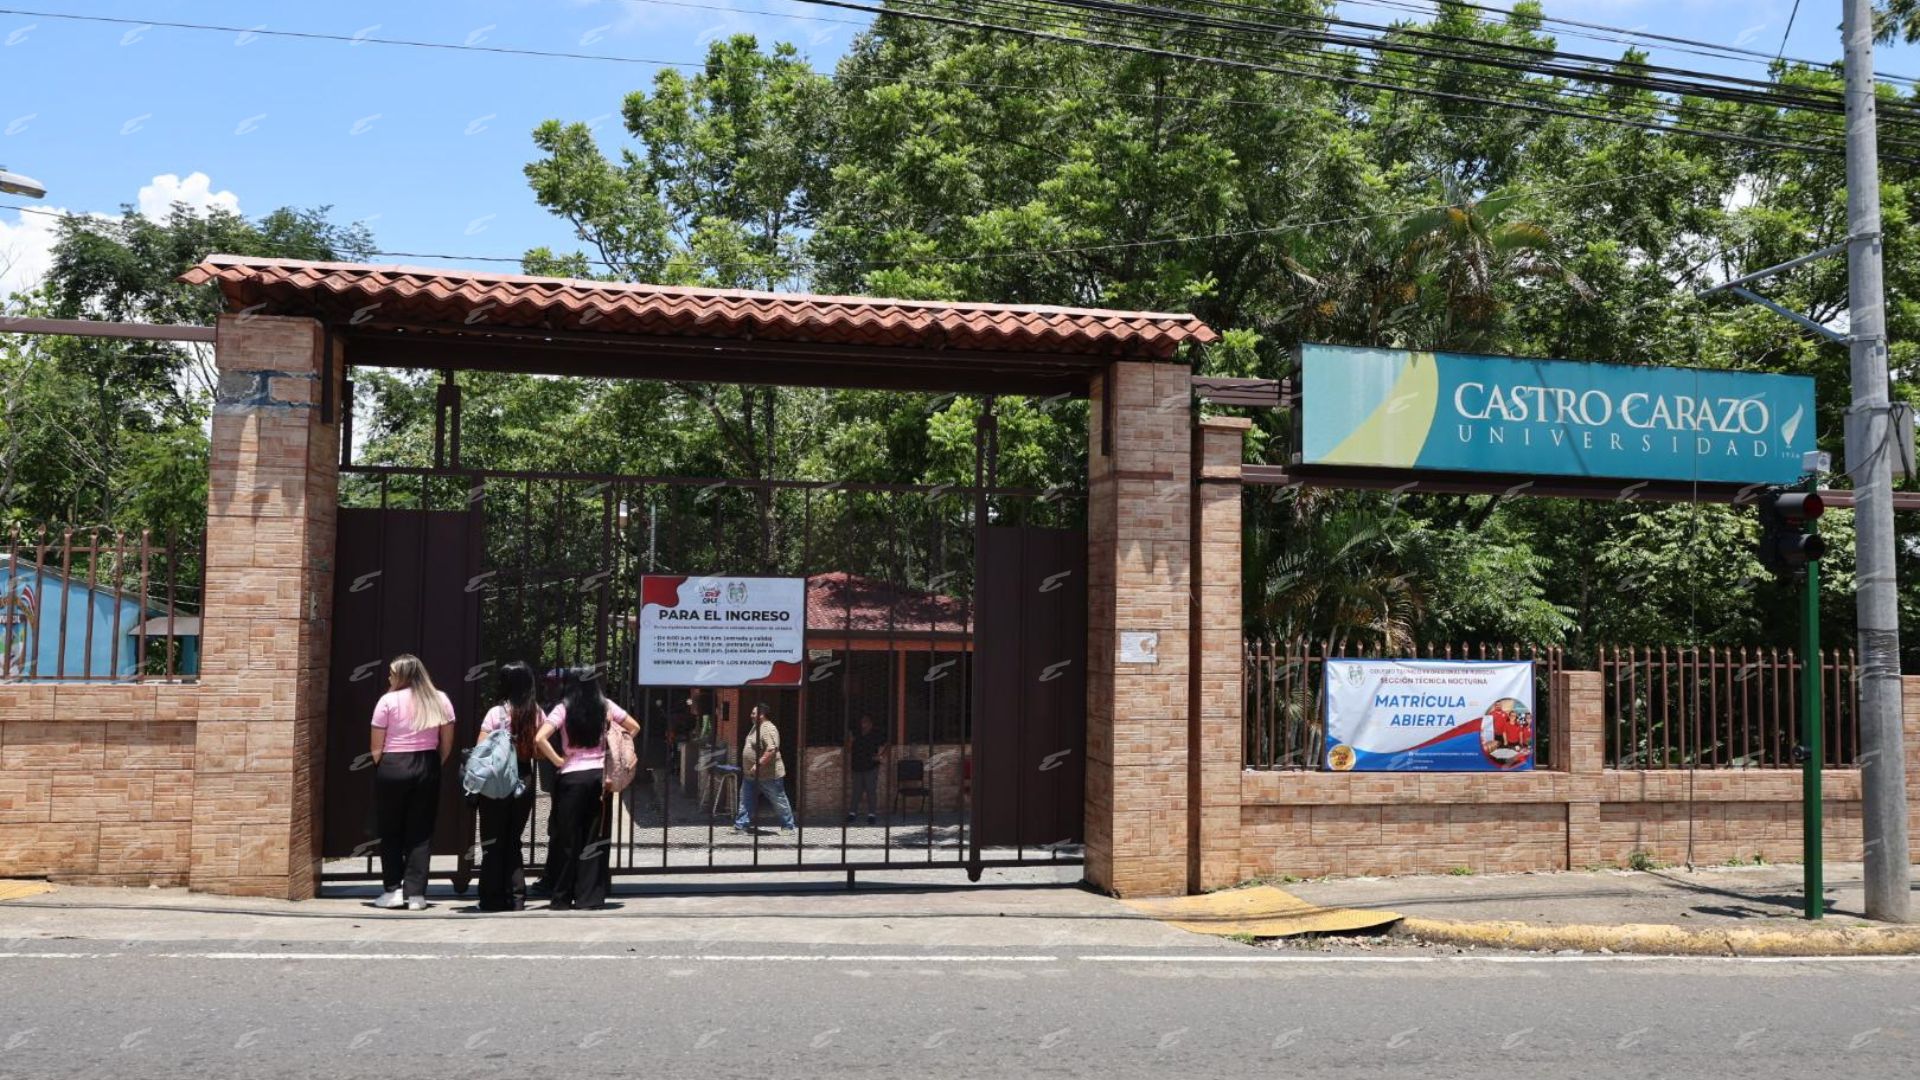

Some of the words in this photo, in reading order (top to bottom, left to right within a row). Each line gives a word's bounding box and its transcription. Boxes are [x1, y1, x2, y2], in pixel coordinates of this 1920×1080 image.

[1454, 382, 1612, 426] CASTRO
[1620, 393, 1769, 434] CARAZO
[1458, 424, 1768, 457] UNIVERSIDAD
[659, 610, 699, 620] PARA
[704, 610, 721, 621] EL
[726, 611, 790, 621] INGRESO
[1375, 692, 1466, 708] MATRÍCULA
[1390, 714, 1455, 727] ABIERTA
